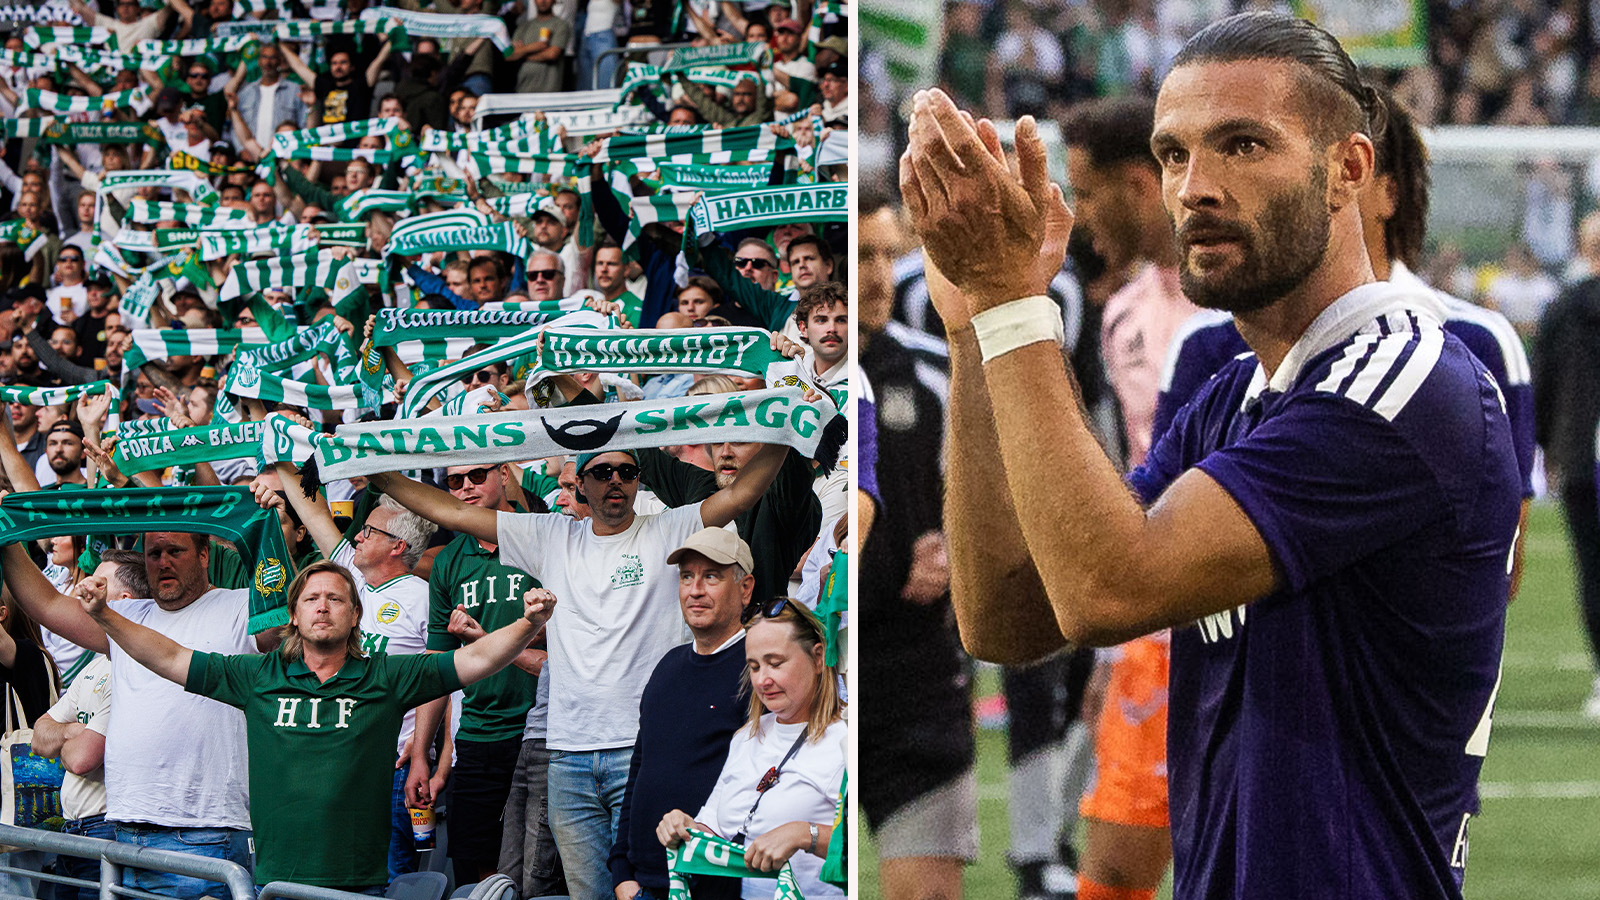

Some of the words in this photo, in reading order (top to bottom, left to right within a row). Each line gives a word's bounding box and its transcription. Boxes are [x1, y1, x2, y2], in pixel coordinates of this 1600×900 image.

[273, 118, 388, 150] BAJEN
[549, 334, 759, 368] HAMMARBY
[118, 435, 175, 461] FORZA
[208, 420, 266, 447] BAJEN
[317, 420, 526, 467] BATANS
[634, 393, 822, 438] SKÄGG
[461, 573, 525, 609] HIF
[273, 697, 357, 729] HIF
